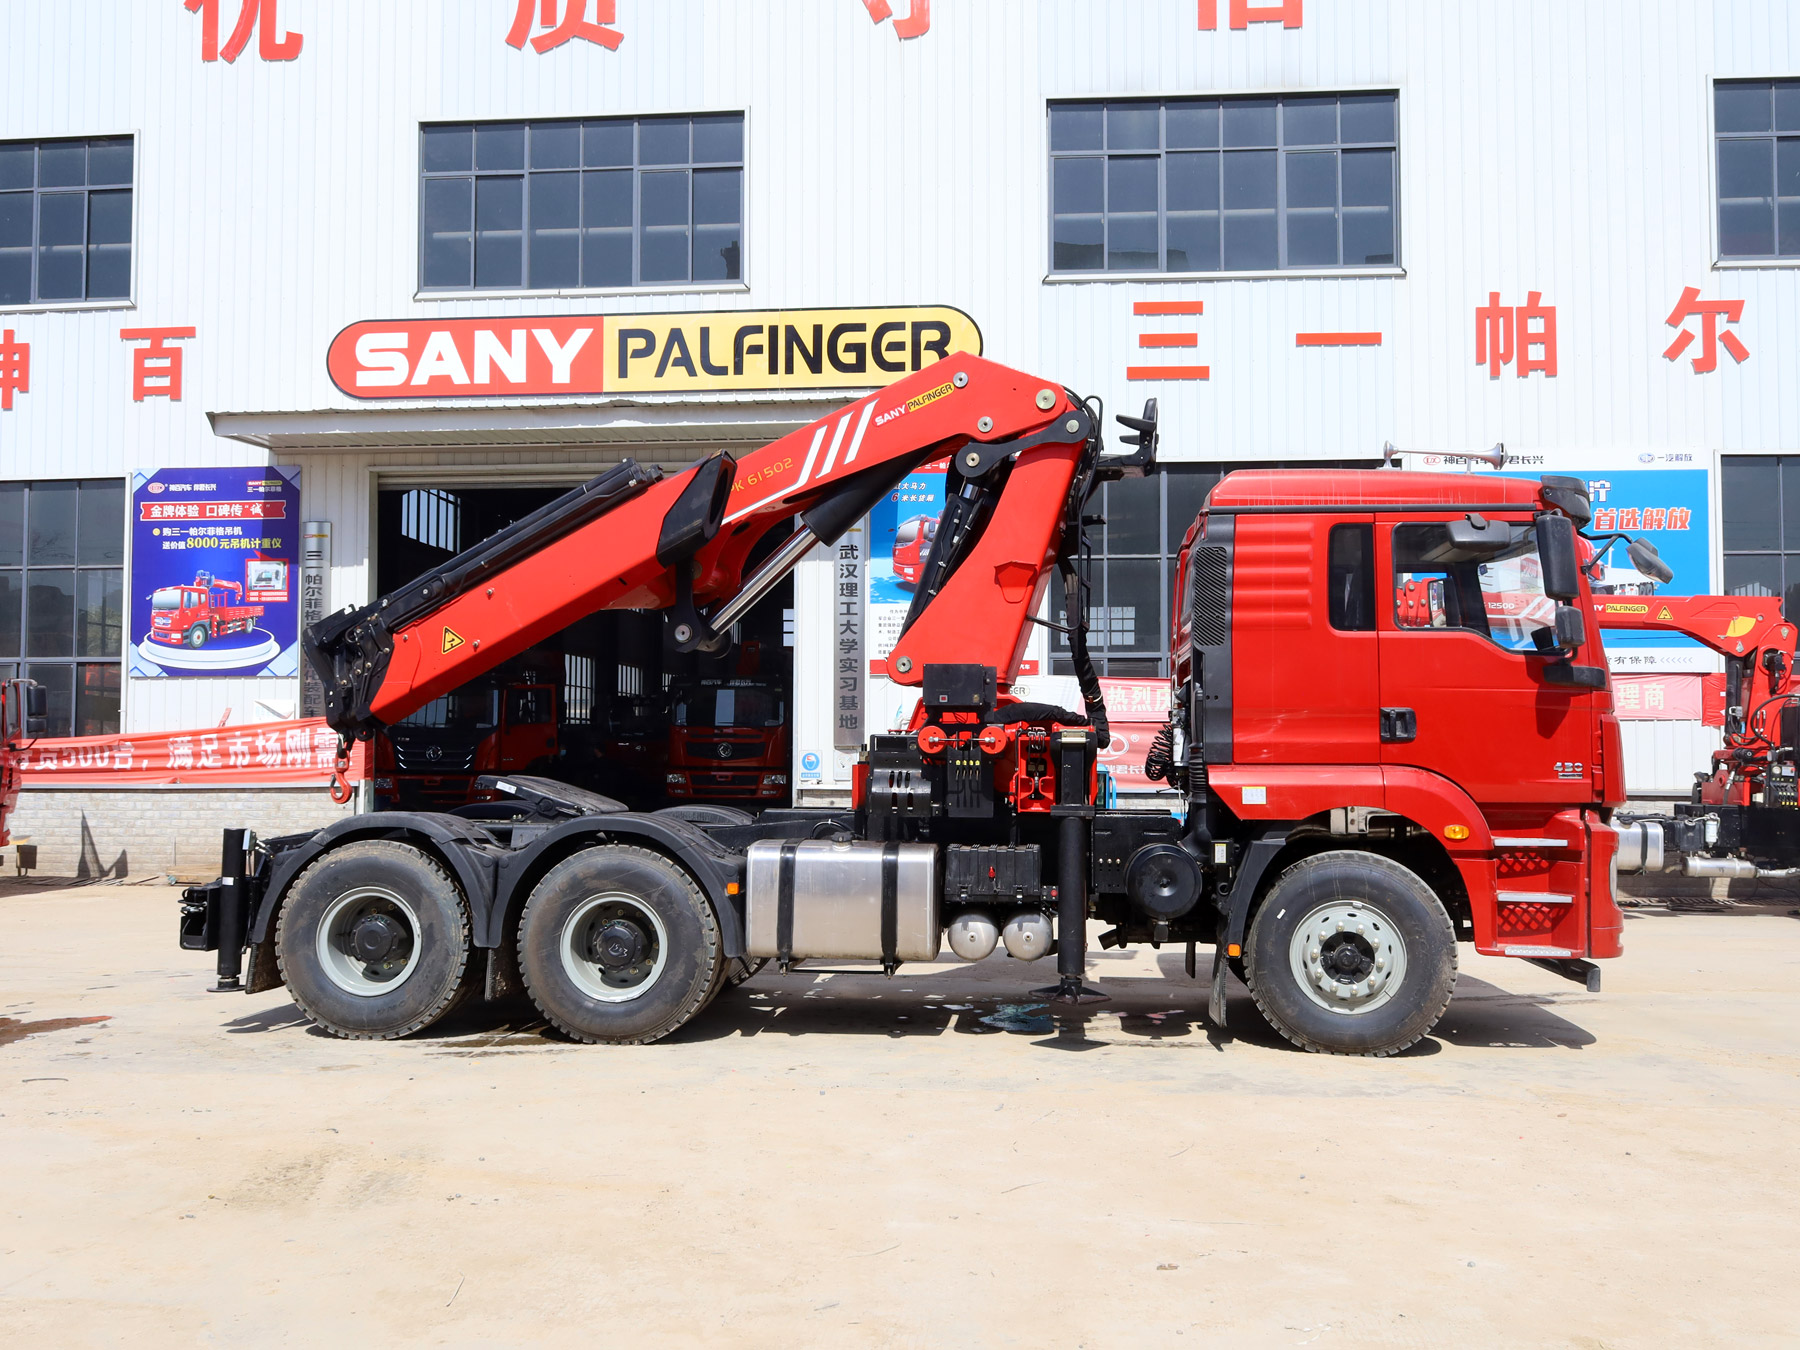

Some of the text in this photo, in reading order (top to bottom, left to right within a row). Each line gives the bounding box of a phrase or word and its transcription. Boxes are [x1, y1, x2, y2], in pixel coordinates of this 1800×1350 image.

[355, 321, 951, 387] SANY PALFINGER
[875, 384, 953, 426] SANY PALFINGER
[747, 457, 793, 485] 61502
[151, 504, 199, 518] 金牌体验
[1593, 507, 1692, 531] 首选解放
[162, 527, 243, 536] 购三一帕尔菲格吊机
[839, 545, 858, 730] 武汉理工大学实习基地
[1617, 683, 1665, 710] 理商
